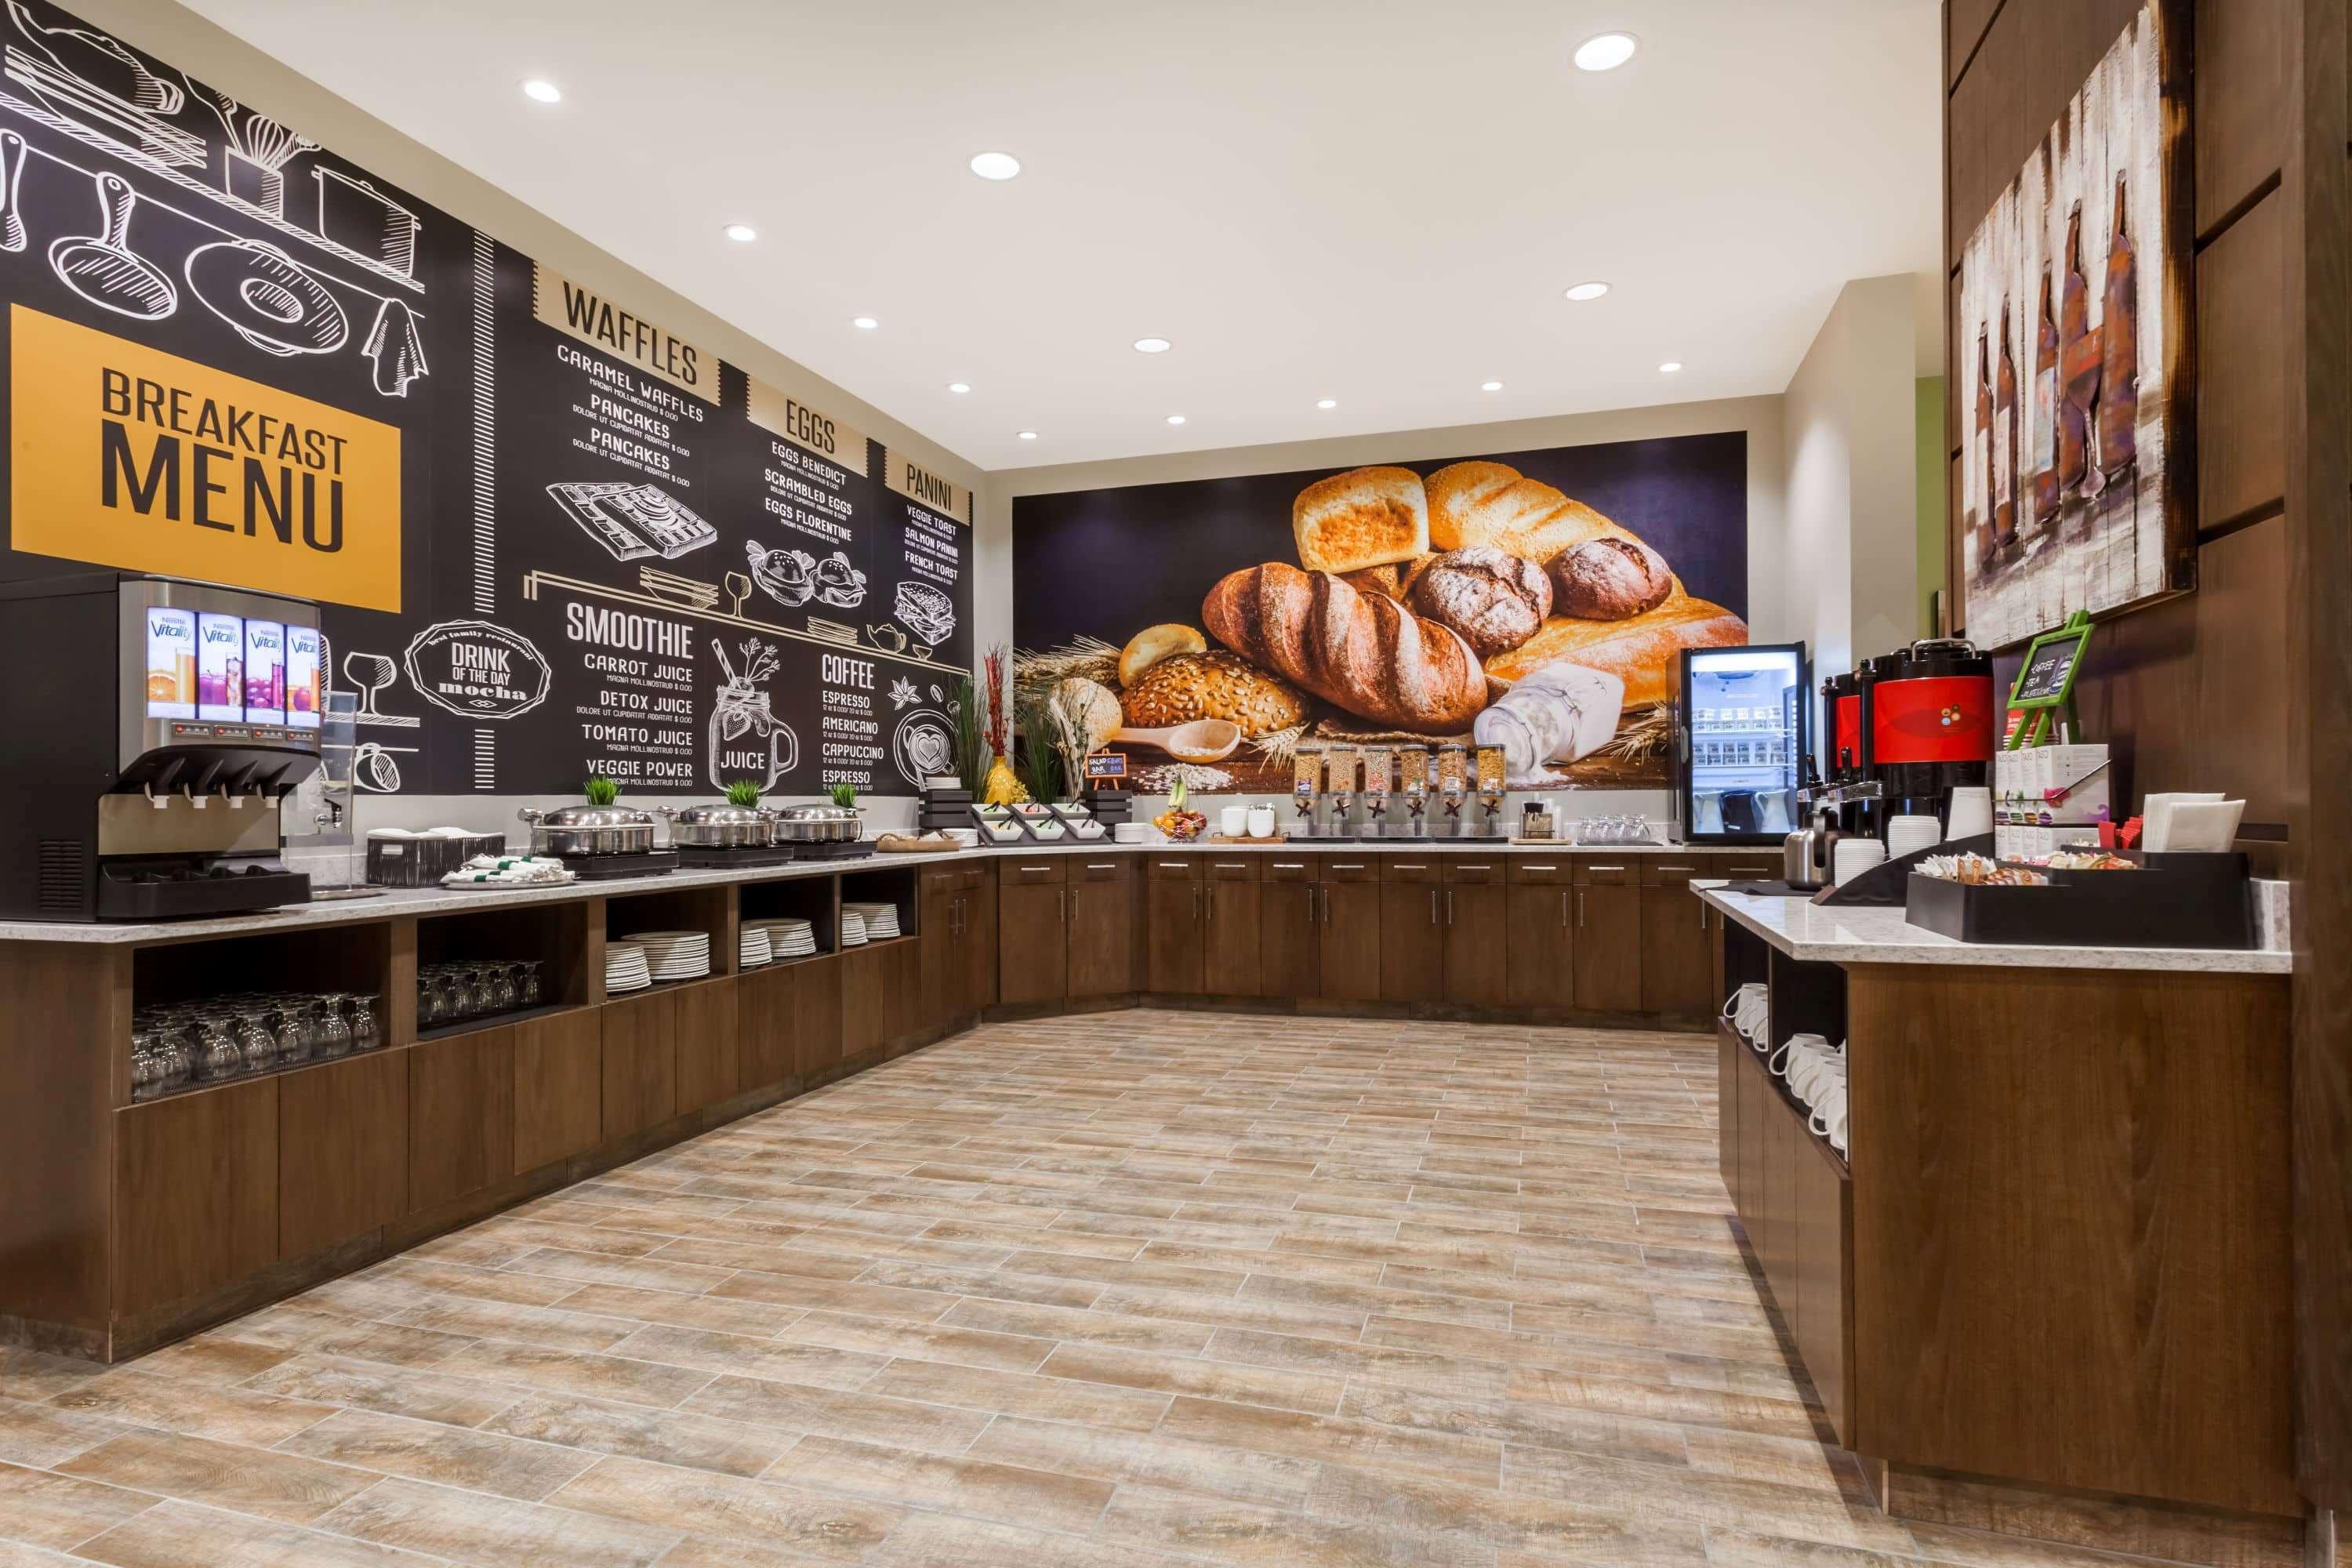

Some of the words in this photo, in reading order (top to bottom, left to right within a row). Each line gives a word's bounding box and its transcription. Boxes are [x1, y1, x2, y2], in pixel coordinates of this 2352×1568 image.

[564, 281, 696, 385] WAFFLES
[557, 345, 633, 391] CARAMEL
[641, 381, 702, 422] WAFFLES
[590, 377, 612, 393] MAGNA
[103, 367, 347, 474] BREAKFAST
[573, 405, 597, 420] DOLORE
[600, 416, 608, 424] UT
[591, 394, 670, 439] PANCAKES
[787, 399, 834, 454] EGGS
[573, 439, 597, 454] DOLORE
[600, 448, 608, 457] UT
[591, 427, 670, 470] PANCAKES
[772, 441, 799, 463] EGGS
[803, 456, 846, 485] BENEDICT
[102, 419, 343, 553] MENU
[765, 469, 825, 503] SCRAMBLED
[829, 495, 851, 515] EGGS
[907, 463, 952, 511] PANINI
[765, 497, 793, 519] EGGS
[797, 510, 851, 541] FLORENTINE
[907, 505, 932, 524] VEGGIE
[934, 517, 956, 535] TOAST
[906, 527, 935, 548] SALMON
[937, 540, 958, 557] PANINI
[906, 550, 933, 571] FRENCH
[935, 563, 958, 580] TOAST
[151, 620, 192, 641] Vitality
[567, 603, 694, 659] SMOOTHIE
[427, 634, 448, 646] best
[485, 633, 534, 660] restaurant
[452, 642, 511, 673] DRINK
[452, 666, 466, 681] OF
[469, 669, 488, 684] THE
[491, 671, 510, 686] DAY
[584, 654, 648, 676] CARROT
[654, 665, 692, 682] JUICE
[607, 674, 628, 684] MAGNA
[630, 677, 673, 689] MOLLINOSTRUD
[822, 653, 875, 690] COFFEE
[438, 682, 527, 701] mocha
[601, 691, 648, 710] DETOX
[654, 697, 692, 713] JUICE
[822, 690, 870, 709] ESPRESSO
[576, 706, 601, 716] DOLORE
[582, 724, 648, 742] TOMATO
[654, 730, 692, 746] JUICE
[822, 717, 878, 734] AMERICANO
[630, 745, 673, 753] MOLLINOSTRUD
[721, 750, 765, 770] JUICE
[822, 742, 884, 760] CAPPUCCINO
[586, 759, 641, 775] VEGGIE
[647, 761, 692, 777] POWER
[822, 770, 870, 783] ESPRESSO
